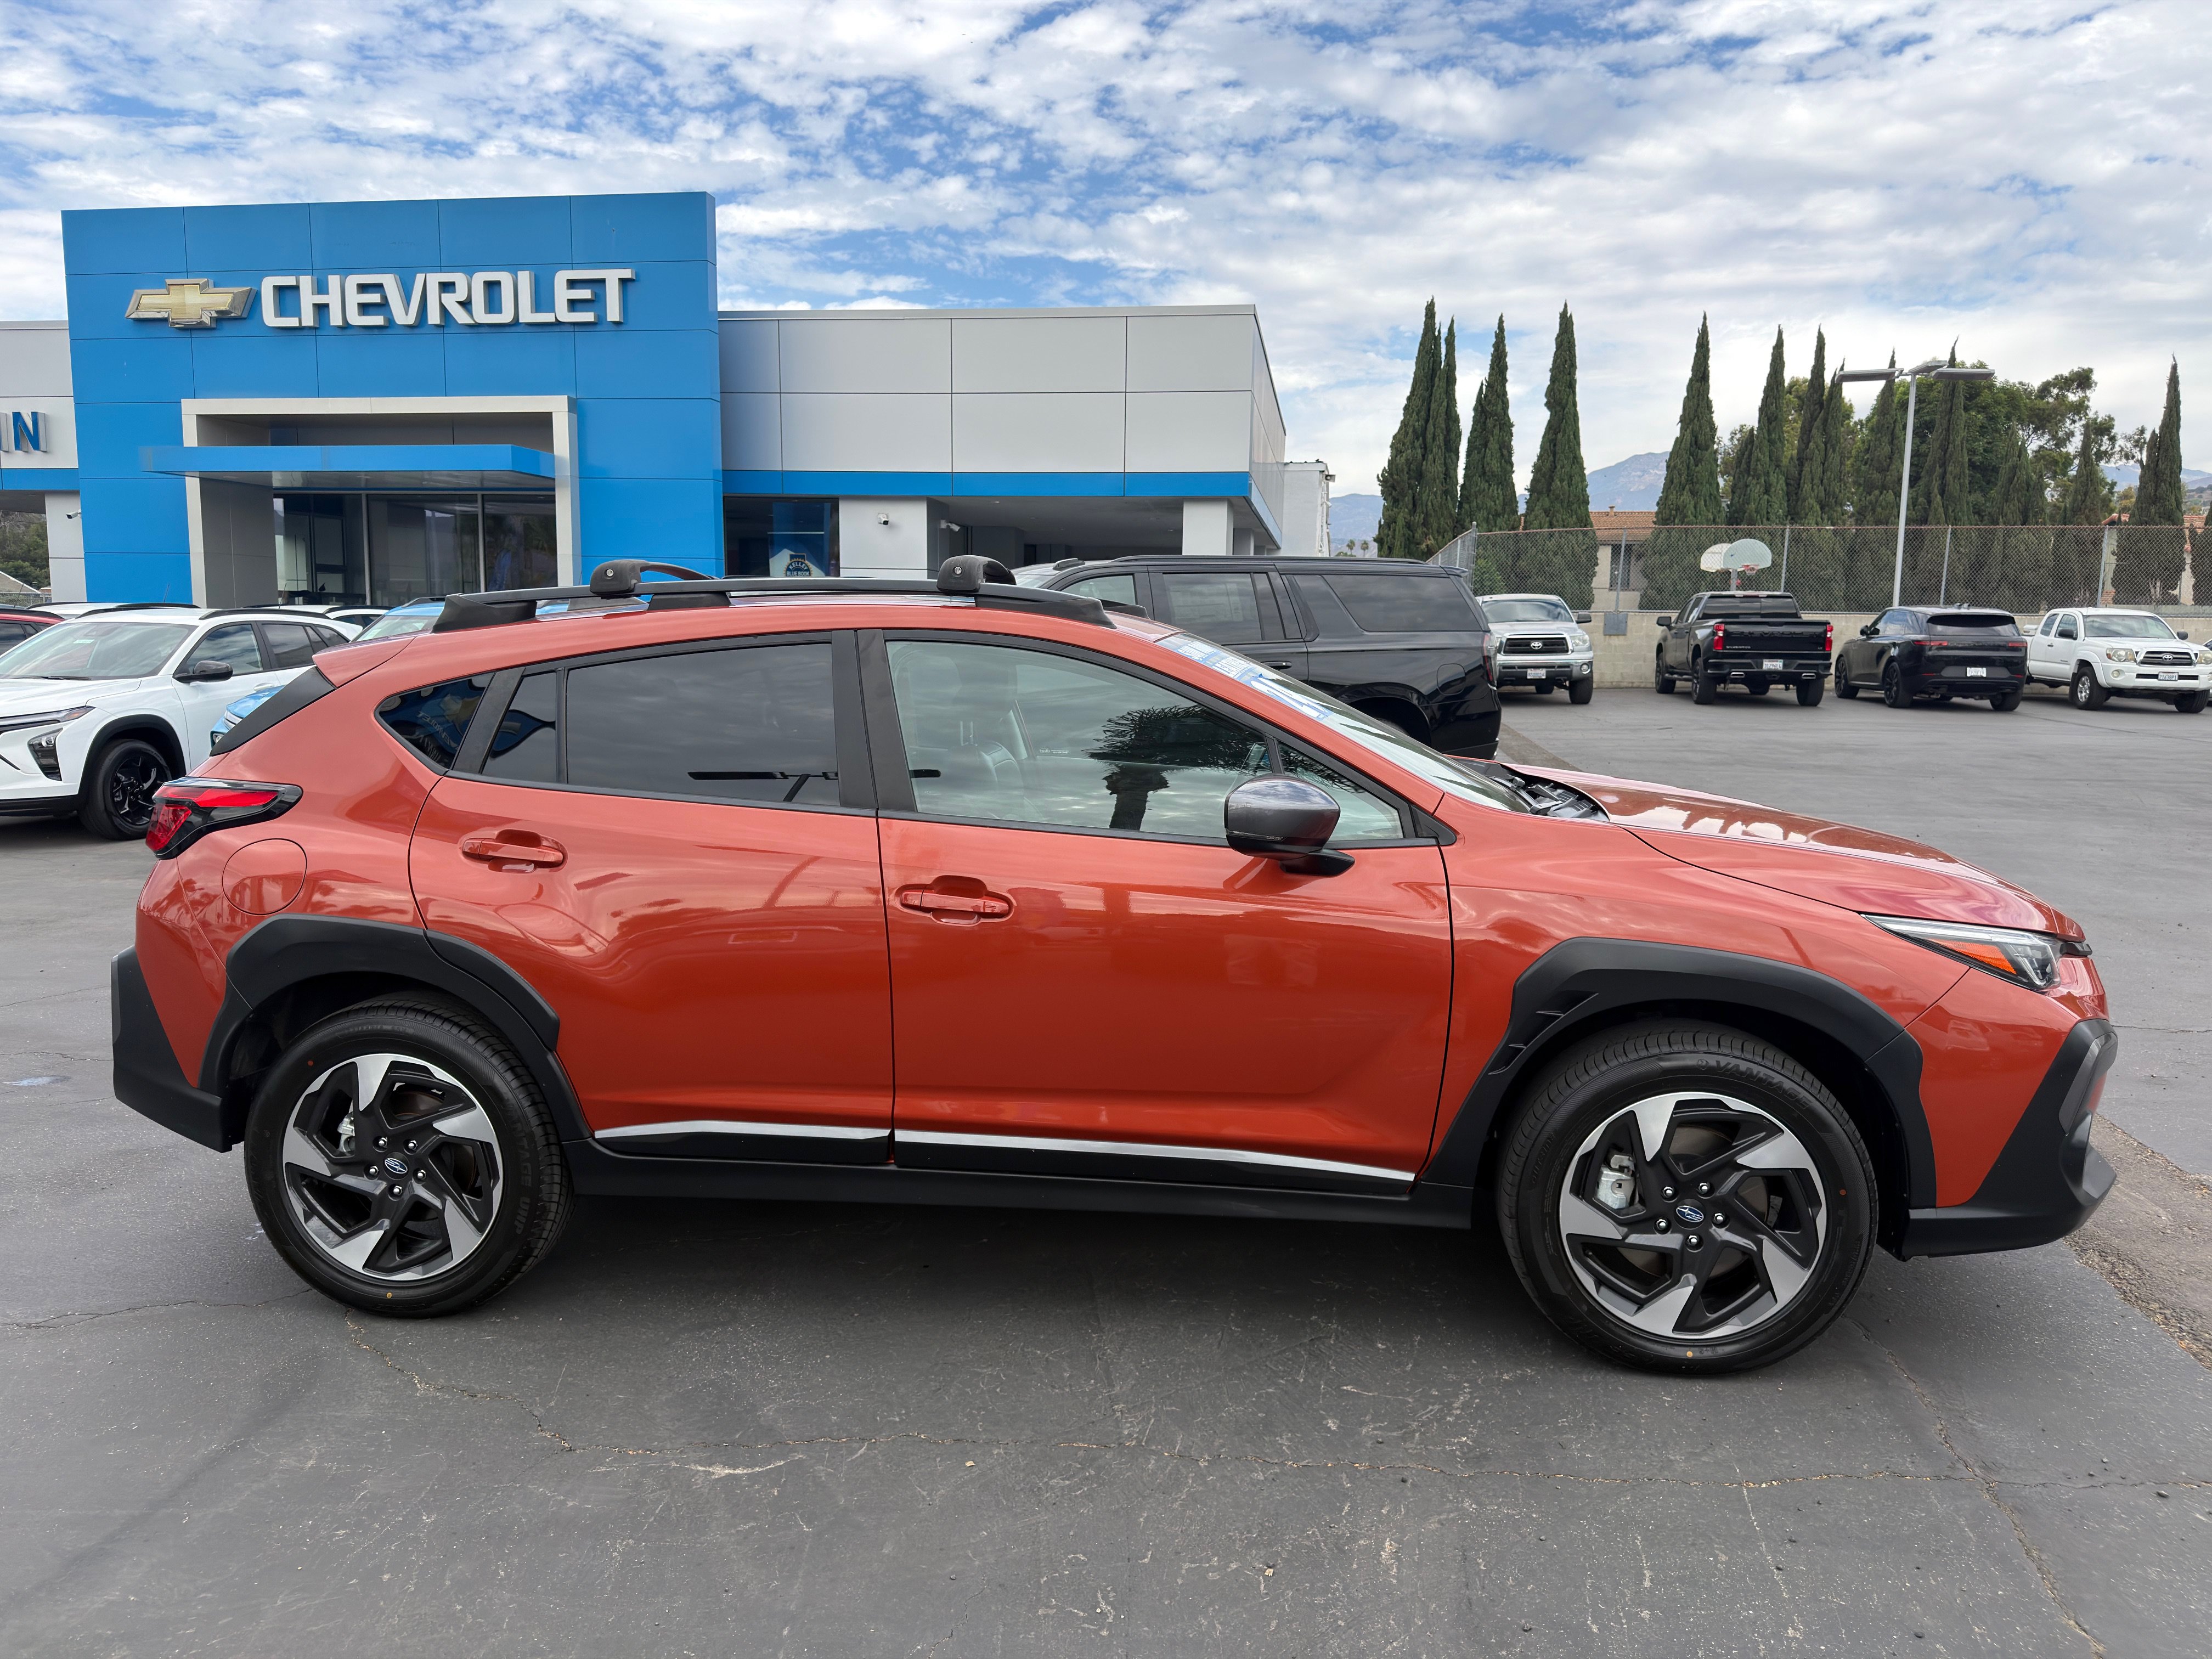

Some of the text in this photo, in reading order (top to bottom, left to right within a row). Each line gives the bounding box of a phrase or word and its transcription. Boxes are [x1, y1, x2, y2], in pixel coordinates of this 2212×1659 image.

[261, 269, 635, 328] CHEVROLET
[0, 411, 47, 452] N
[789, 562, 808, 570] KELLEY
[1715, 1059, 1813, 1110] VANTAGE
